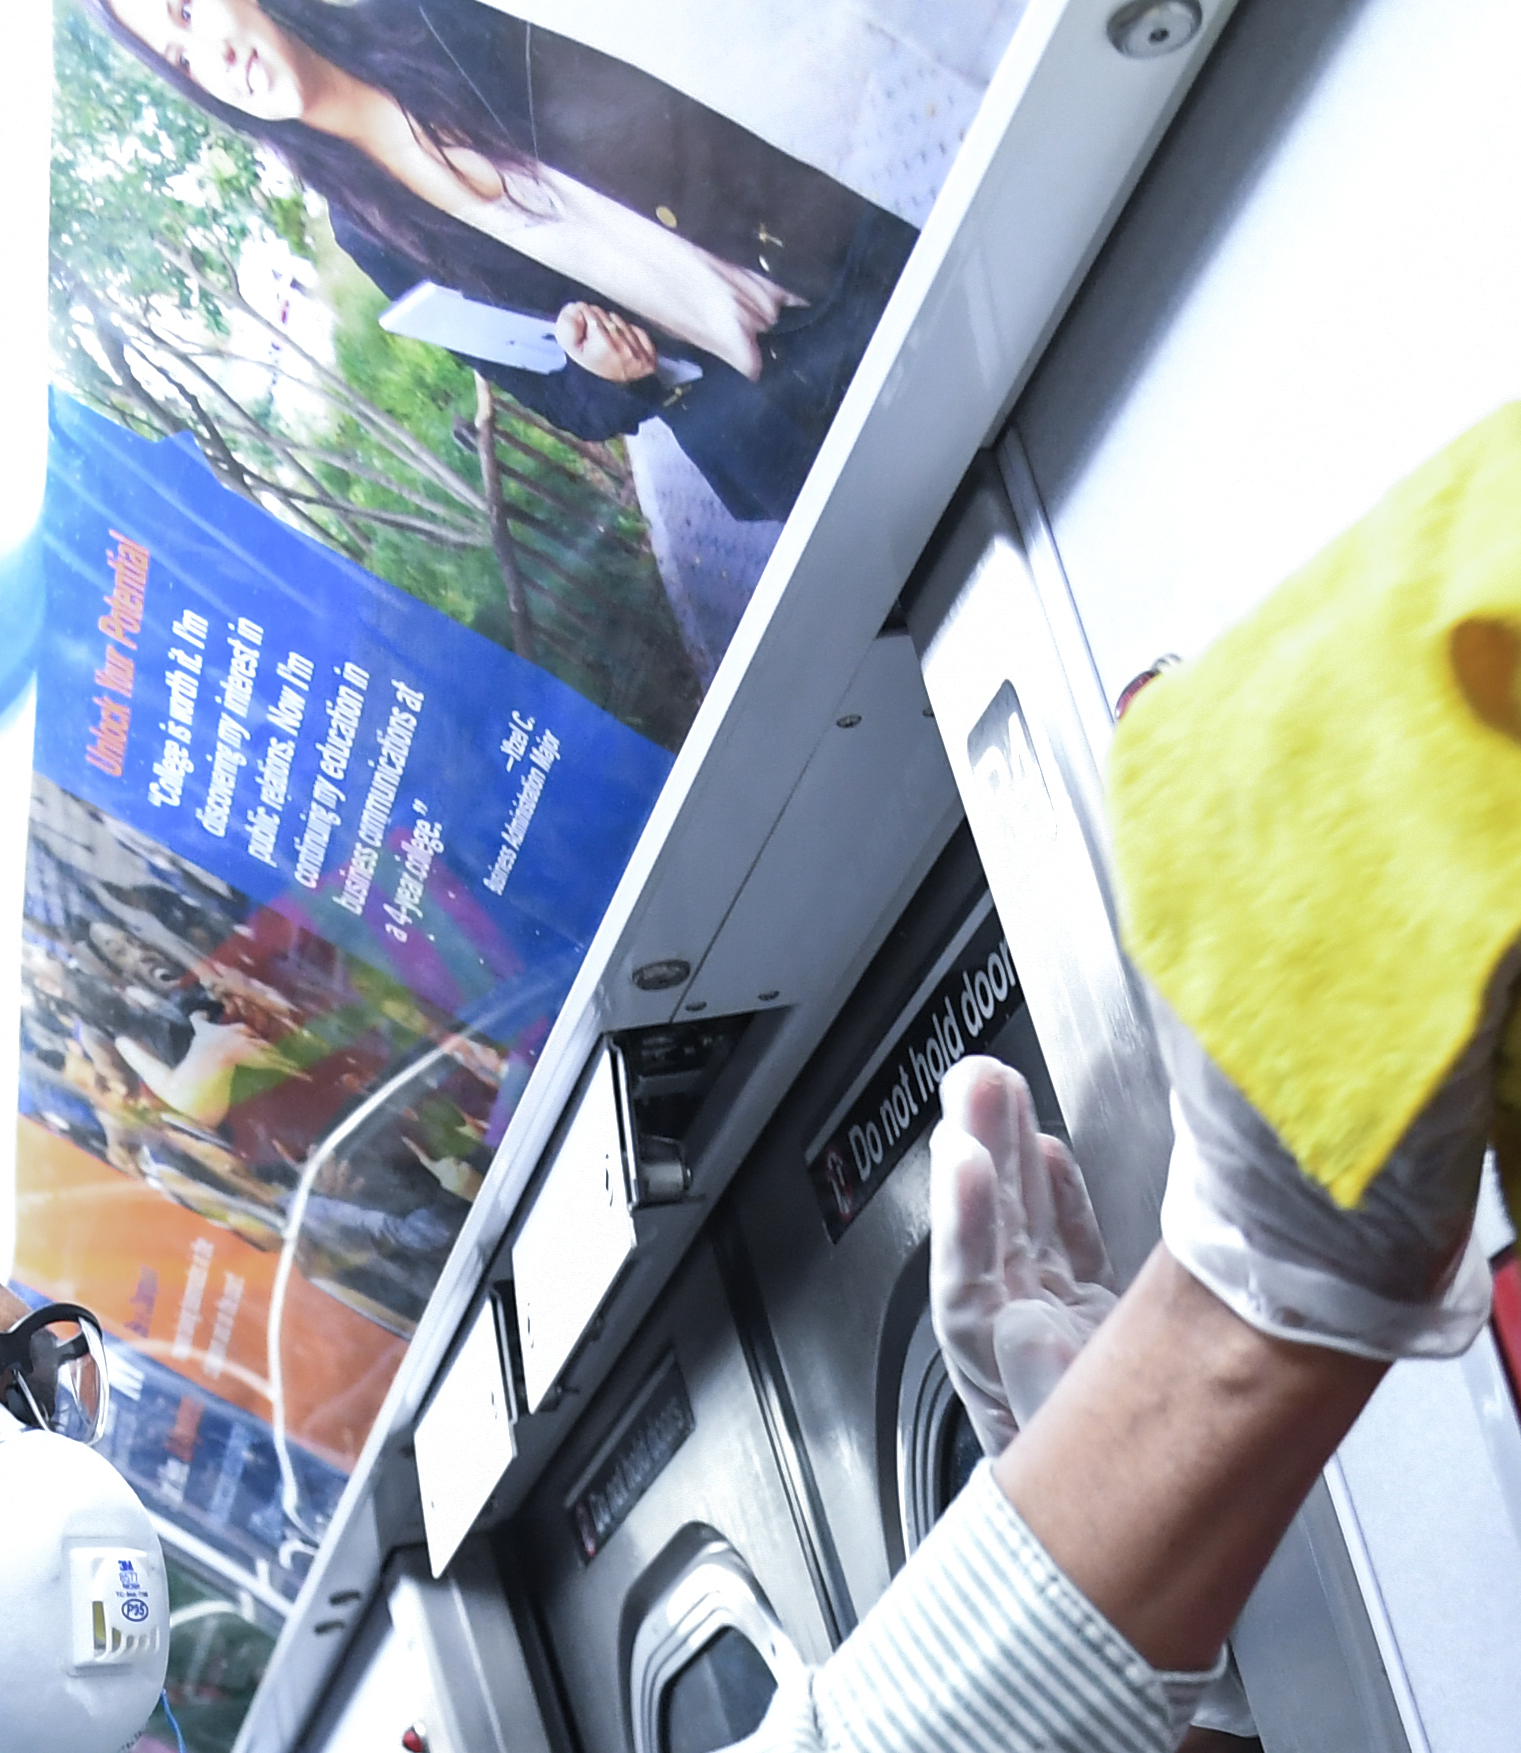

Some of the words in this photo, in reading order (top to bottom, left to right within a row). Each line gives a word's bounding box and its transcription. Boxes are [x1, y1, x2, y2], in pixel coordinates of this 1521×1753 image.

[97, 528, 150, 650] Potential
[168, 647, 203, 675] it.
[228, 616, 264, 646] in
[94, 644, 136, 698] Your
[165, 670, 199, 726] worth
[215, 637, 260, 718] interest
[333, 661, 370, 691] in
[85, 696, 131, 777] Unlock
[159, 720, 193, 745] is
[217, 711, 251, 745] my
[267, 684, 306, 737] Now
[315, 684, 365, 780] education
[195, 741, 247, 837] discovering
[255, 736, 296, 811] relations.
[311, 774, 346, 810] my
[332, 842, 379, 917] business
[358, 705, 418, 848] communications
[391, 678, 425, 713] at
[501, 766, 547, 852] Administration
[529, 728, 562, 774] Major
[245, 806, 280, 868] public
[293, 801, 341, 889] continuing
[384, 922, 408, 943] a
[847, 1120, 884, 1183] Do
[879, 1064, 919, 1147] not
[908, 996, 966, 1103] hold
